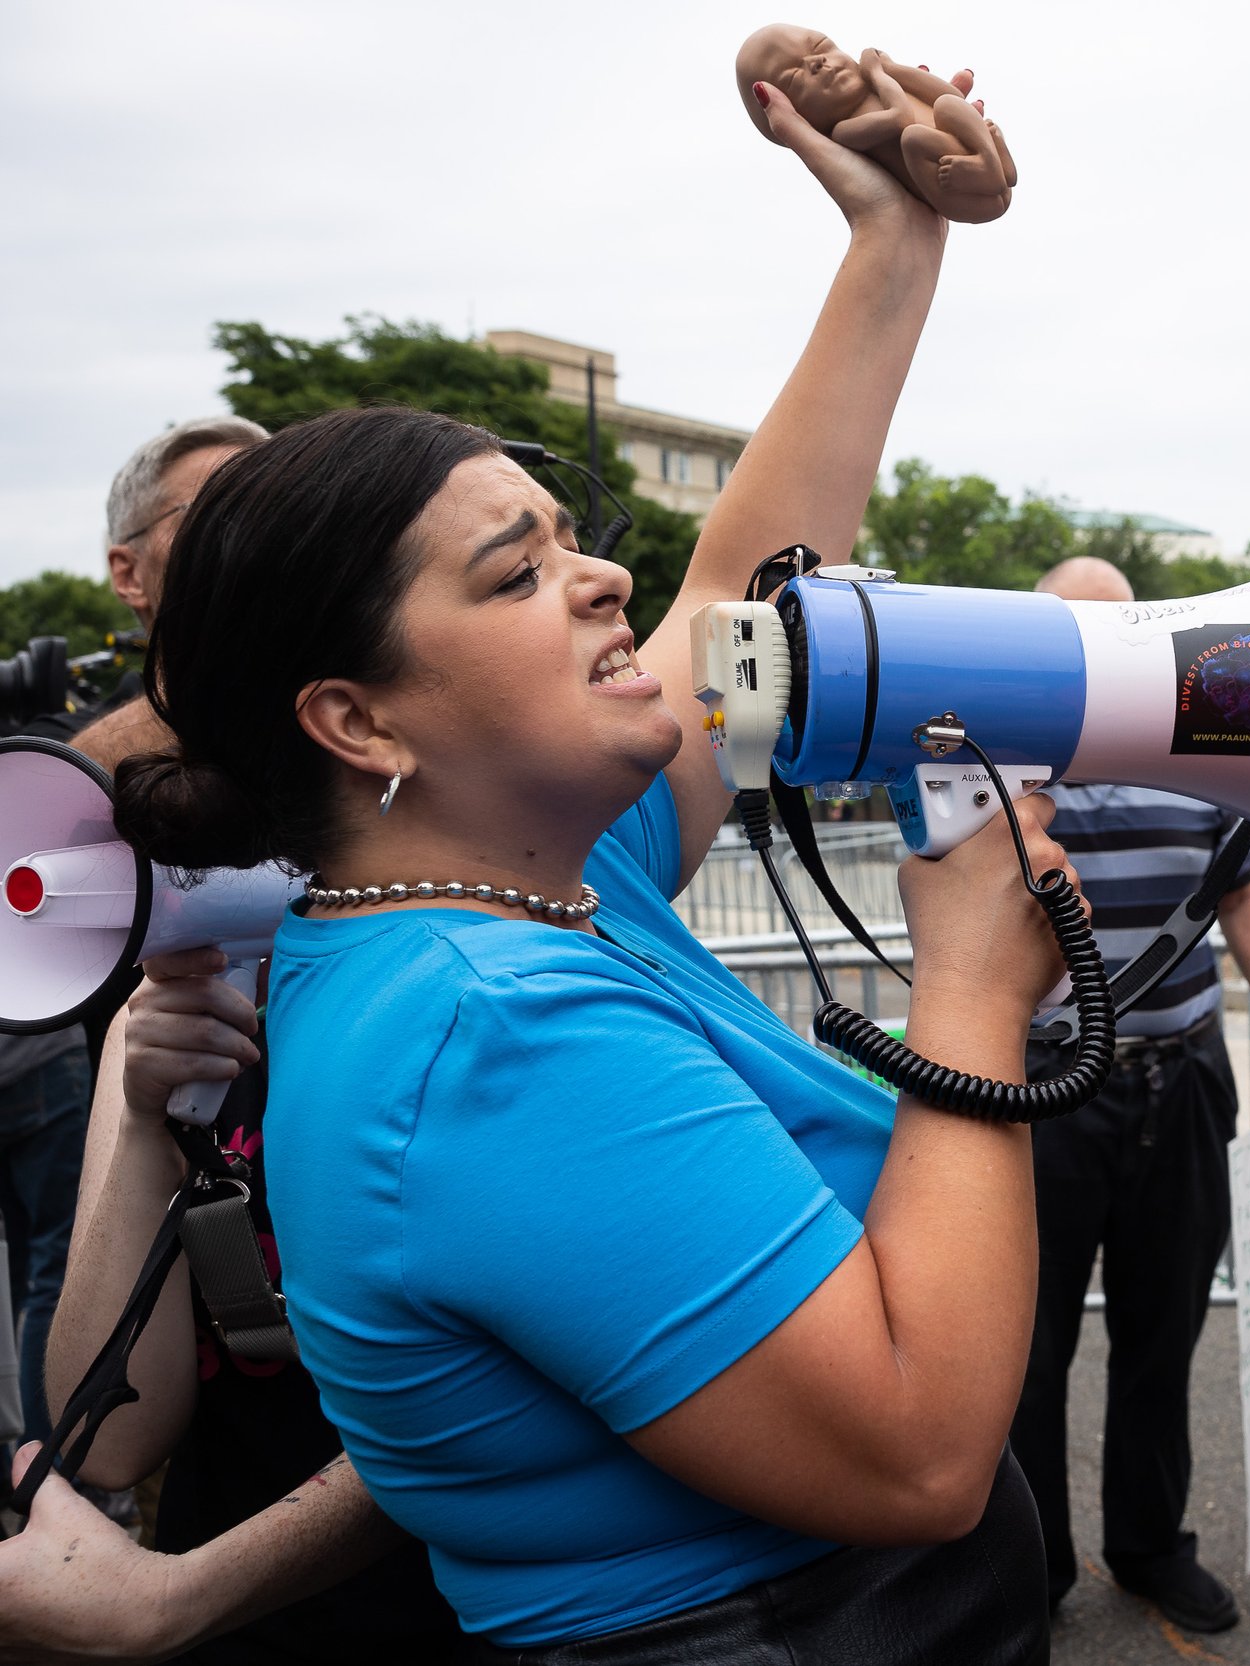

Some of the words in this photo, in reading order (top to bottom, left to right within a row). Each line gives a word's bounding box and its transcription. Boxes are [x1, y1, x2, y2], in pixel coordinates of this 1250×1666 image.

[733, 619, 741, 629] ON
[736, 662, 744, 688] VOLUME
[1181, 664, 1199, 711] DIVEST
[1197, 642, 1229, 663] FROM
